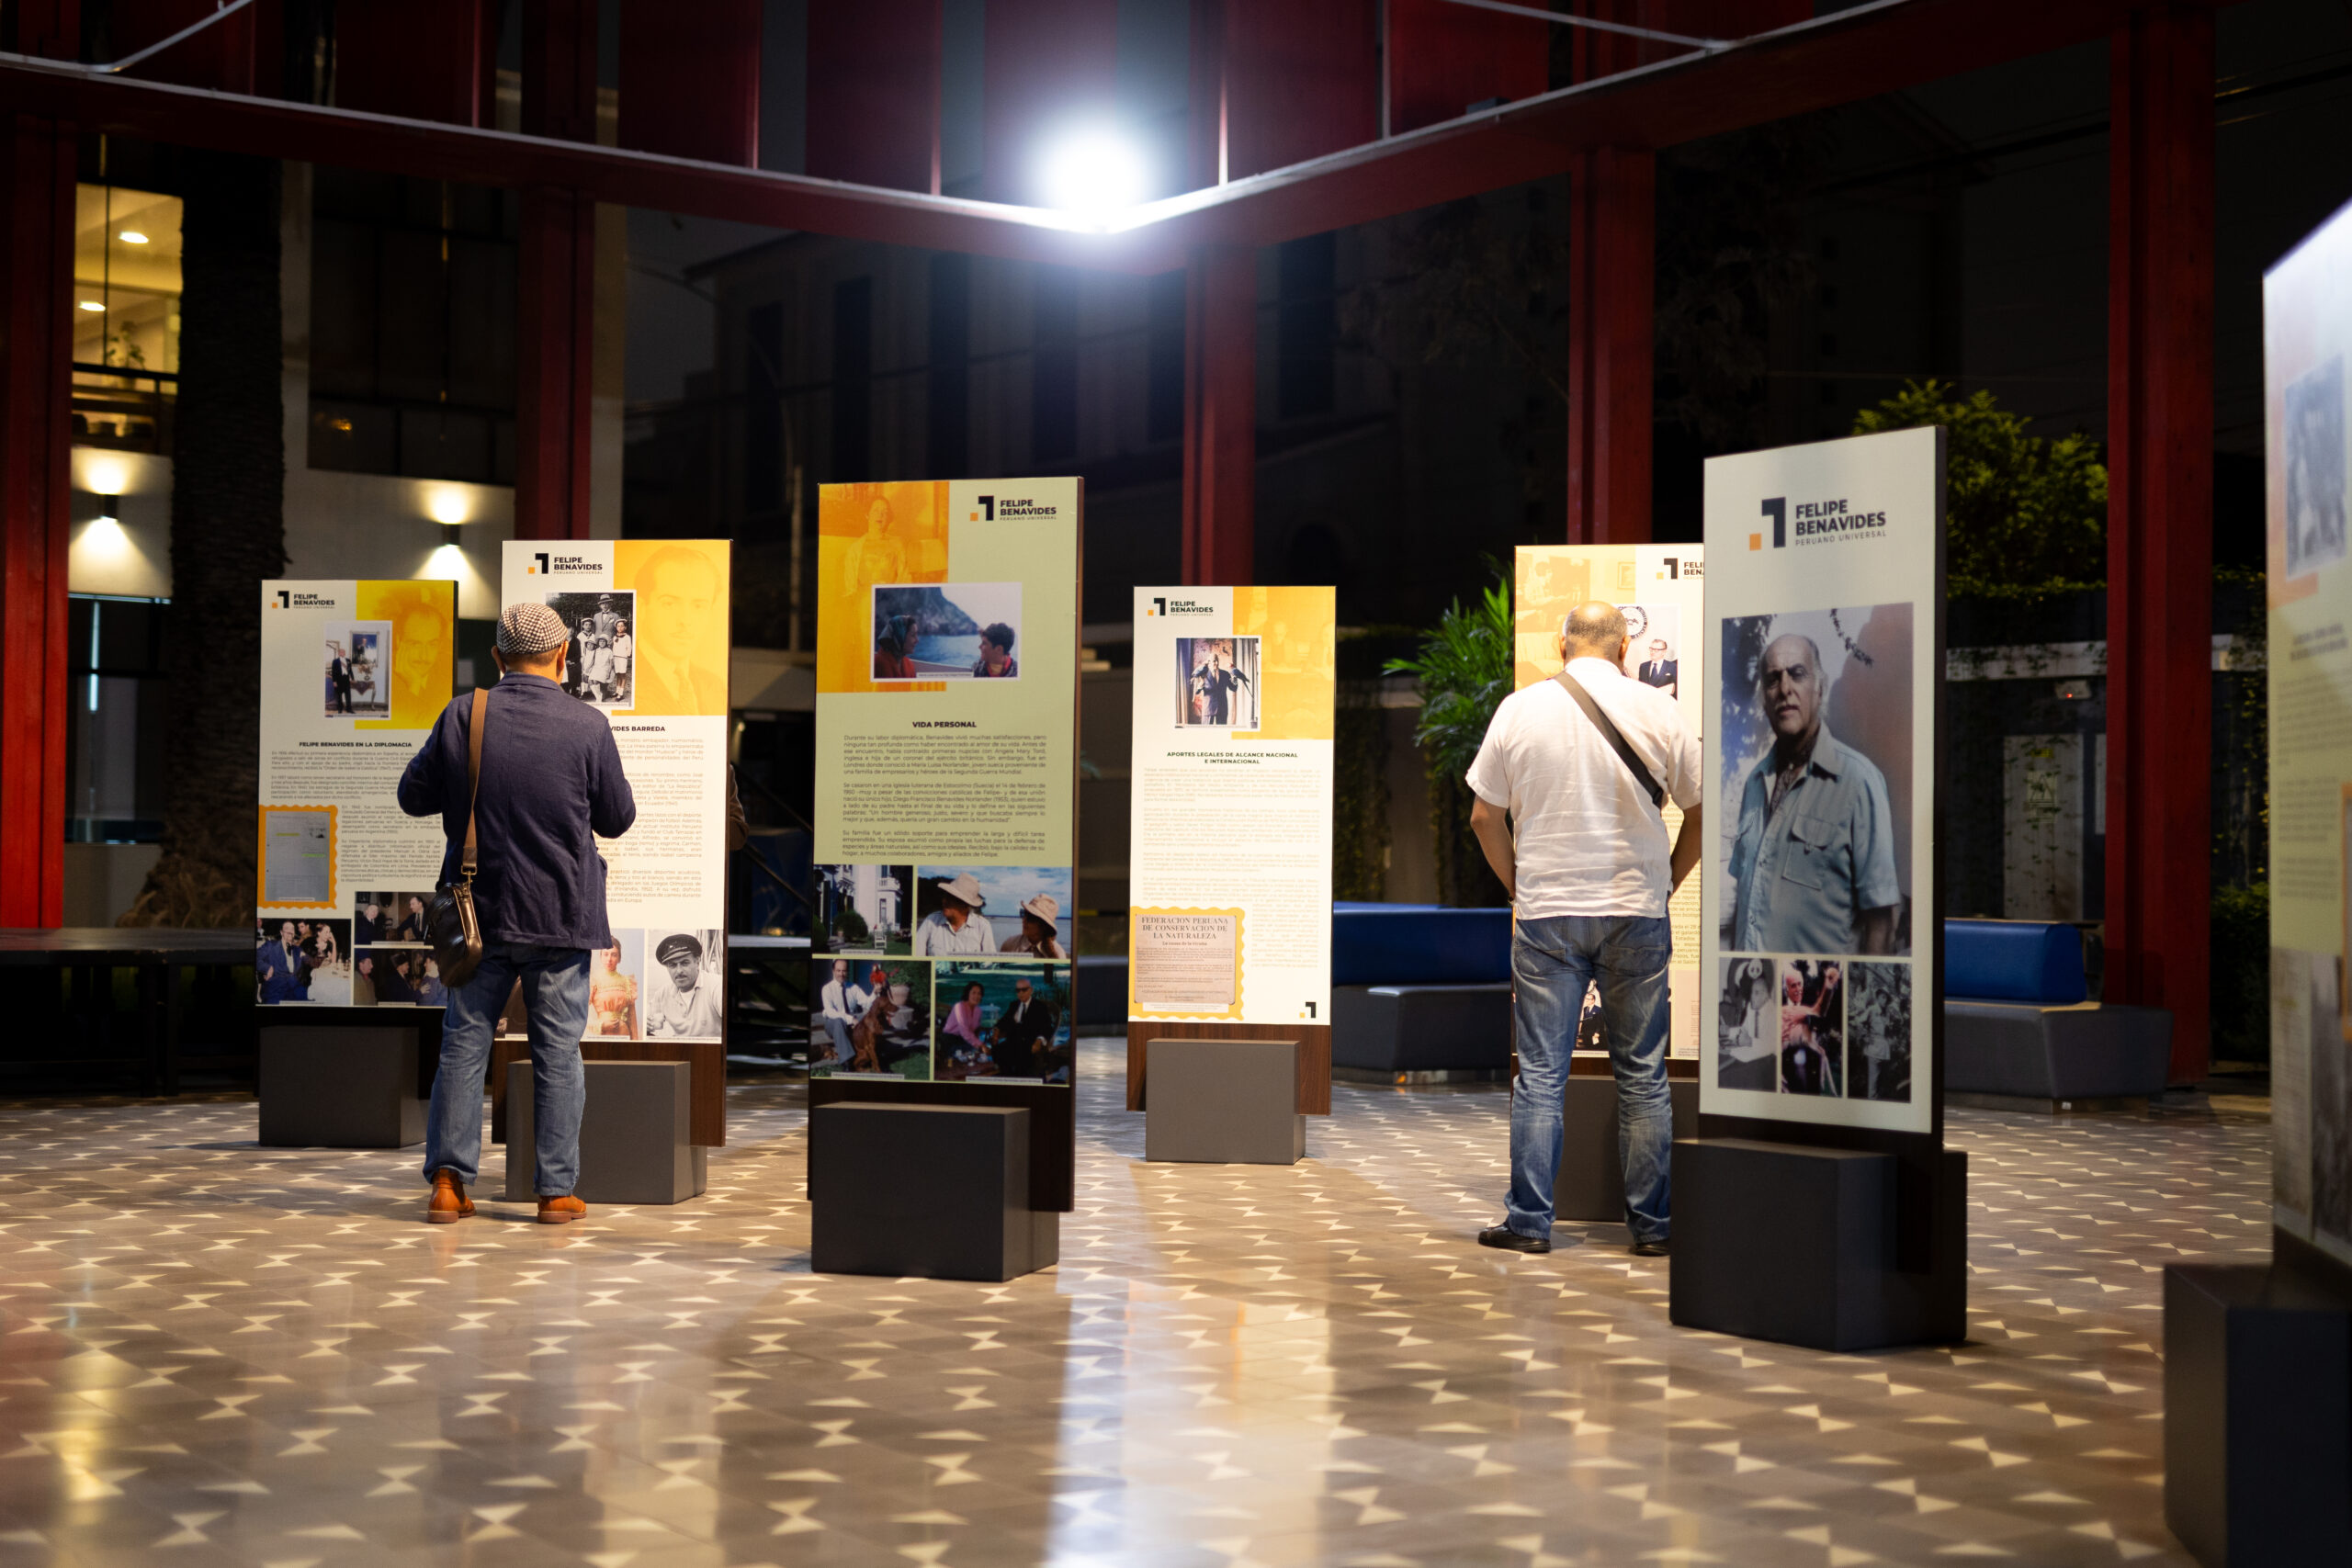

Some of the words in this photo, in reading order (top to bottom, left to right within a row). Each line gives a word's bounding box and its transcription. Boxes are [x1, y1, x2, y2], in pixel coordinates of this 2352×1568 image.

[1000, 507, 1057, 516] BENAVIDES
[1796, 499, 1848, 519] FELIPE
[1796, 512, 1886, 536] BENAVIDES
[1796, 535, 1836, 546] PERUANO
[1839, 530, 1887, 541] UNIVERSAL
